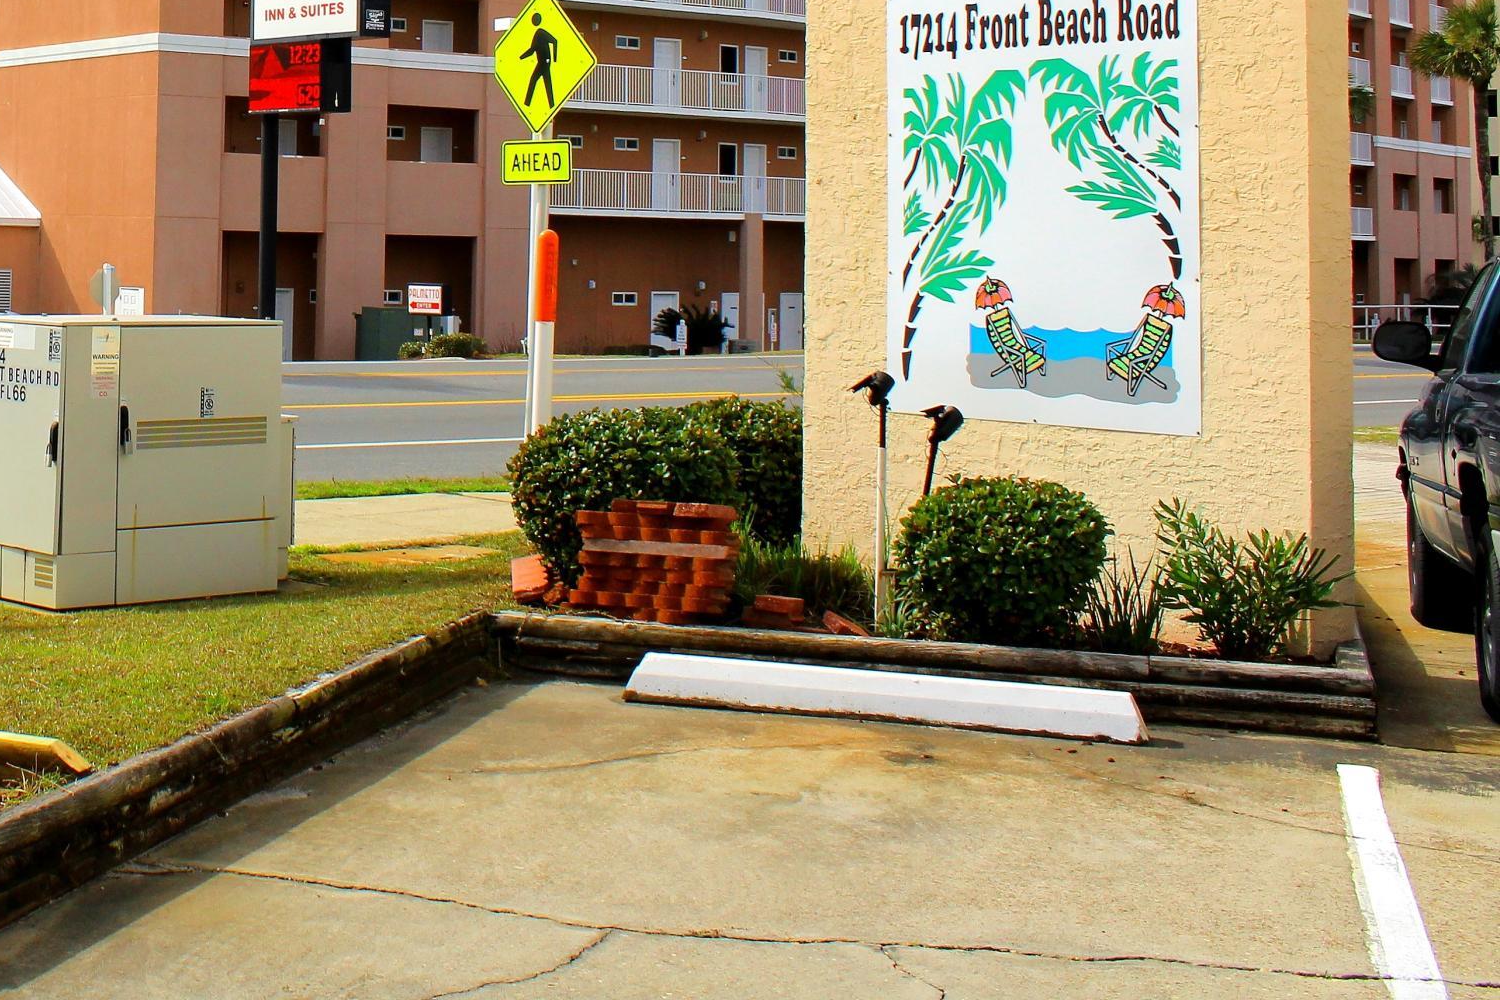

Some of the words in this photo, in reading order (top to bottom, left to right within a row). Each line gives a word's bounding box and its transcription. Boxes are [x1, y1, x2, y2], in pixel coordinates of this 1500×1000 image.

[264, 8, 285, 22] INN
[288, 6, 296, 19] &
[300, 1, 344, 18] SUITES
[899, 12, 957, 60] 17214
[965, 3, 1029, 51] Front
[511, 152, 562, 172] AHEAD
[409, 288, 440, 299] PALMETTO
[8, 368, 42, 384] BEACH
[46, 371, 60, 386] RD
